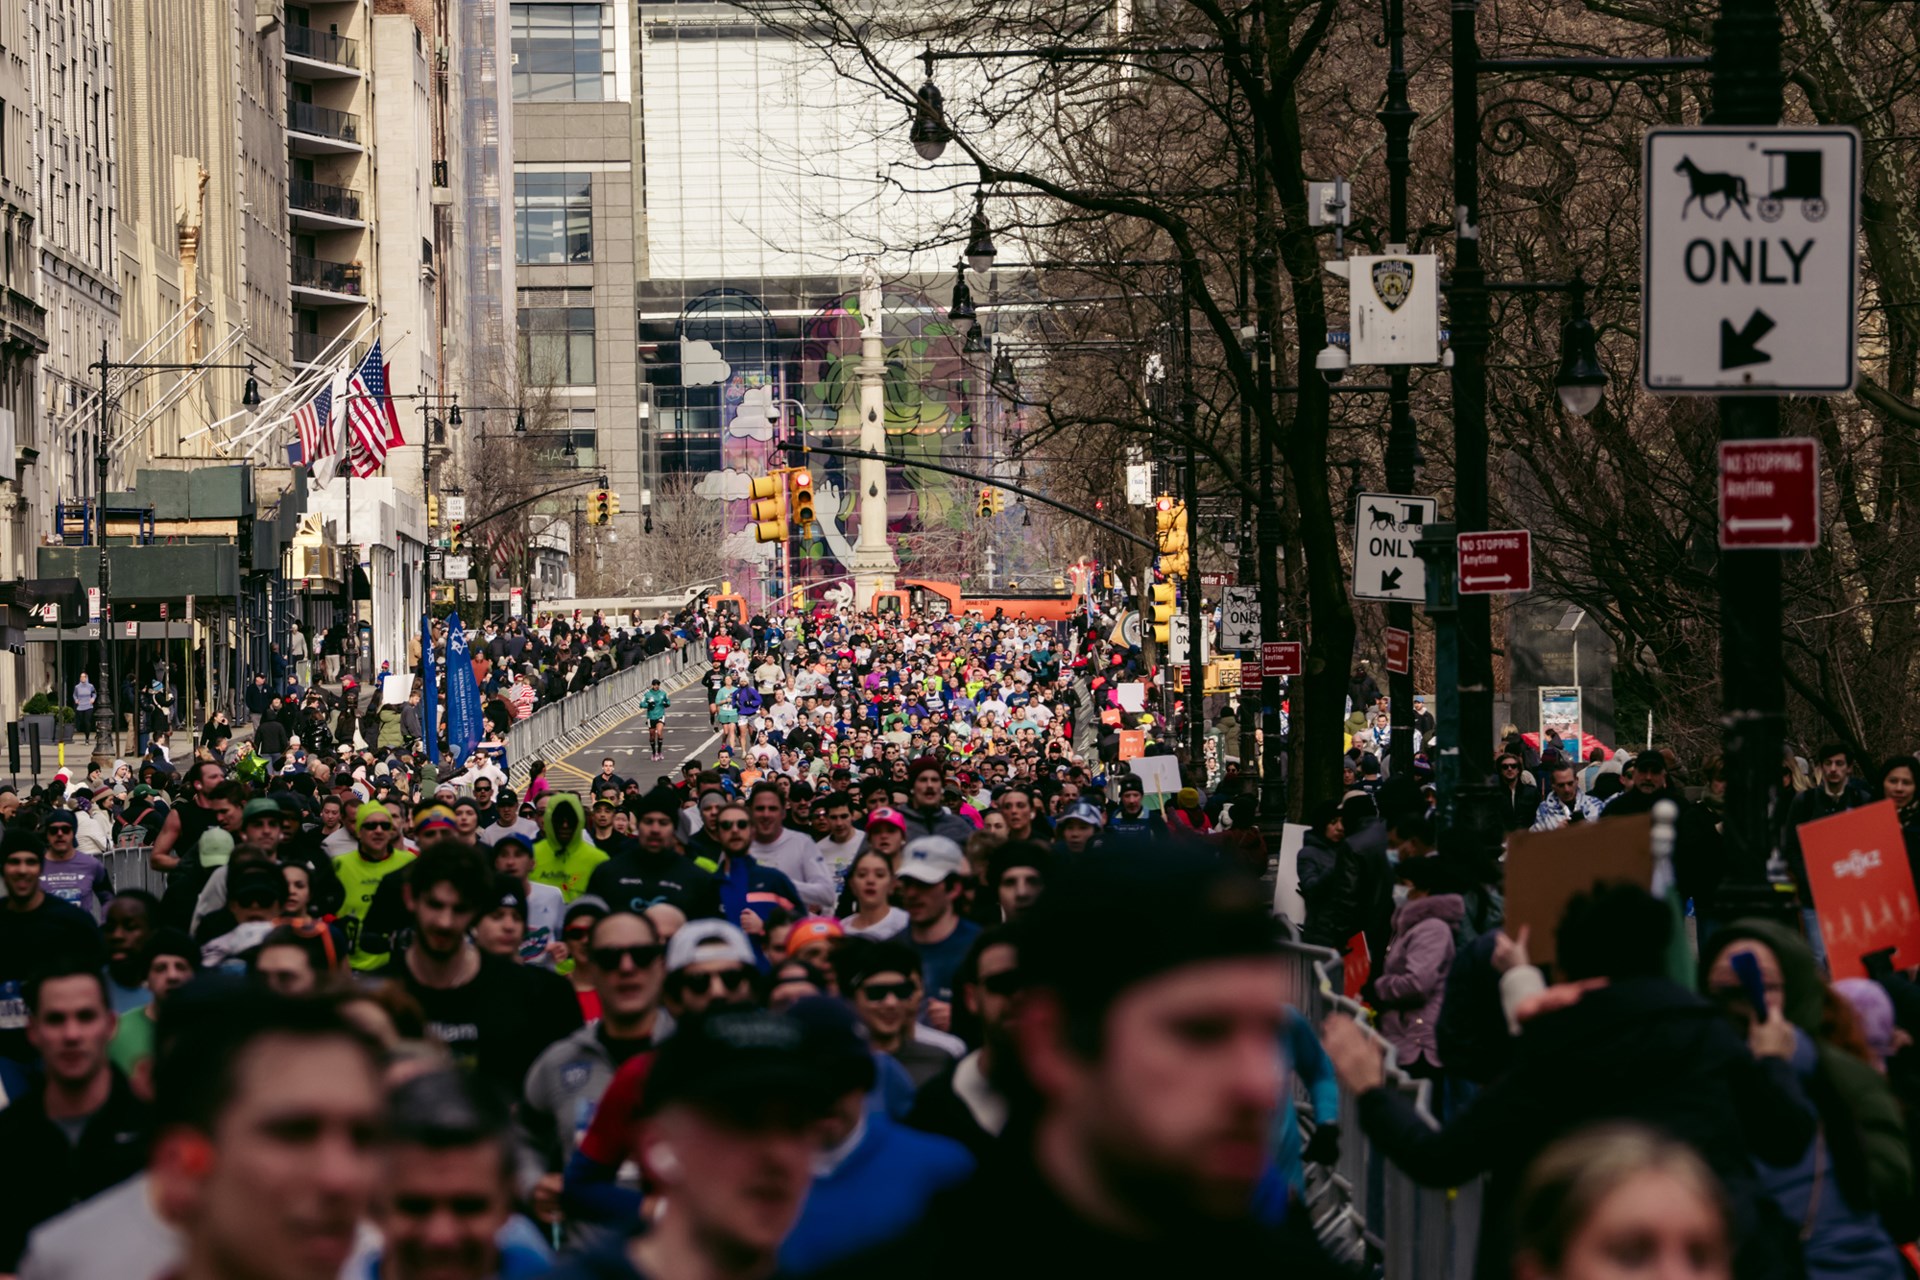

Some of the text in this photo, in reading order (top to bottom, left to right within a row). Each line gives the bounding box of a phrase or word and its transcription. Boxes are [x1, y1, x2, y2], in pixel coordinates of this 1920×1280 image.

[1684, 238, 1815, 286] ONLY
[1727, 452, 1803, 473] NO STOPPING
[1726, 480, 1774, 500] Anytime
[1462, 538, 1519, 552] NO STOPPING
[1463, 554, 1498, 567] Anytime
[1200, 575, 1218, 585] enter
[1273, 645, 1295, 653] STOPPING
[1264, 654, 1284, 662] Anytime
[458, 667, 467, 696] RUNNERS
[460, 696, 468, 720] JEWISH
